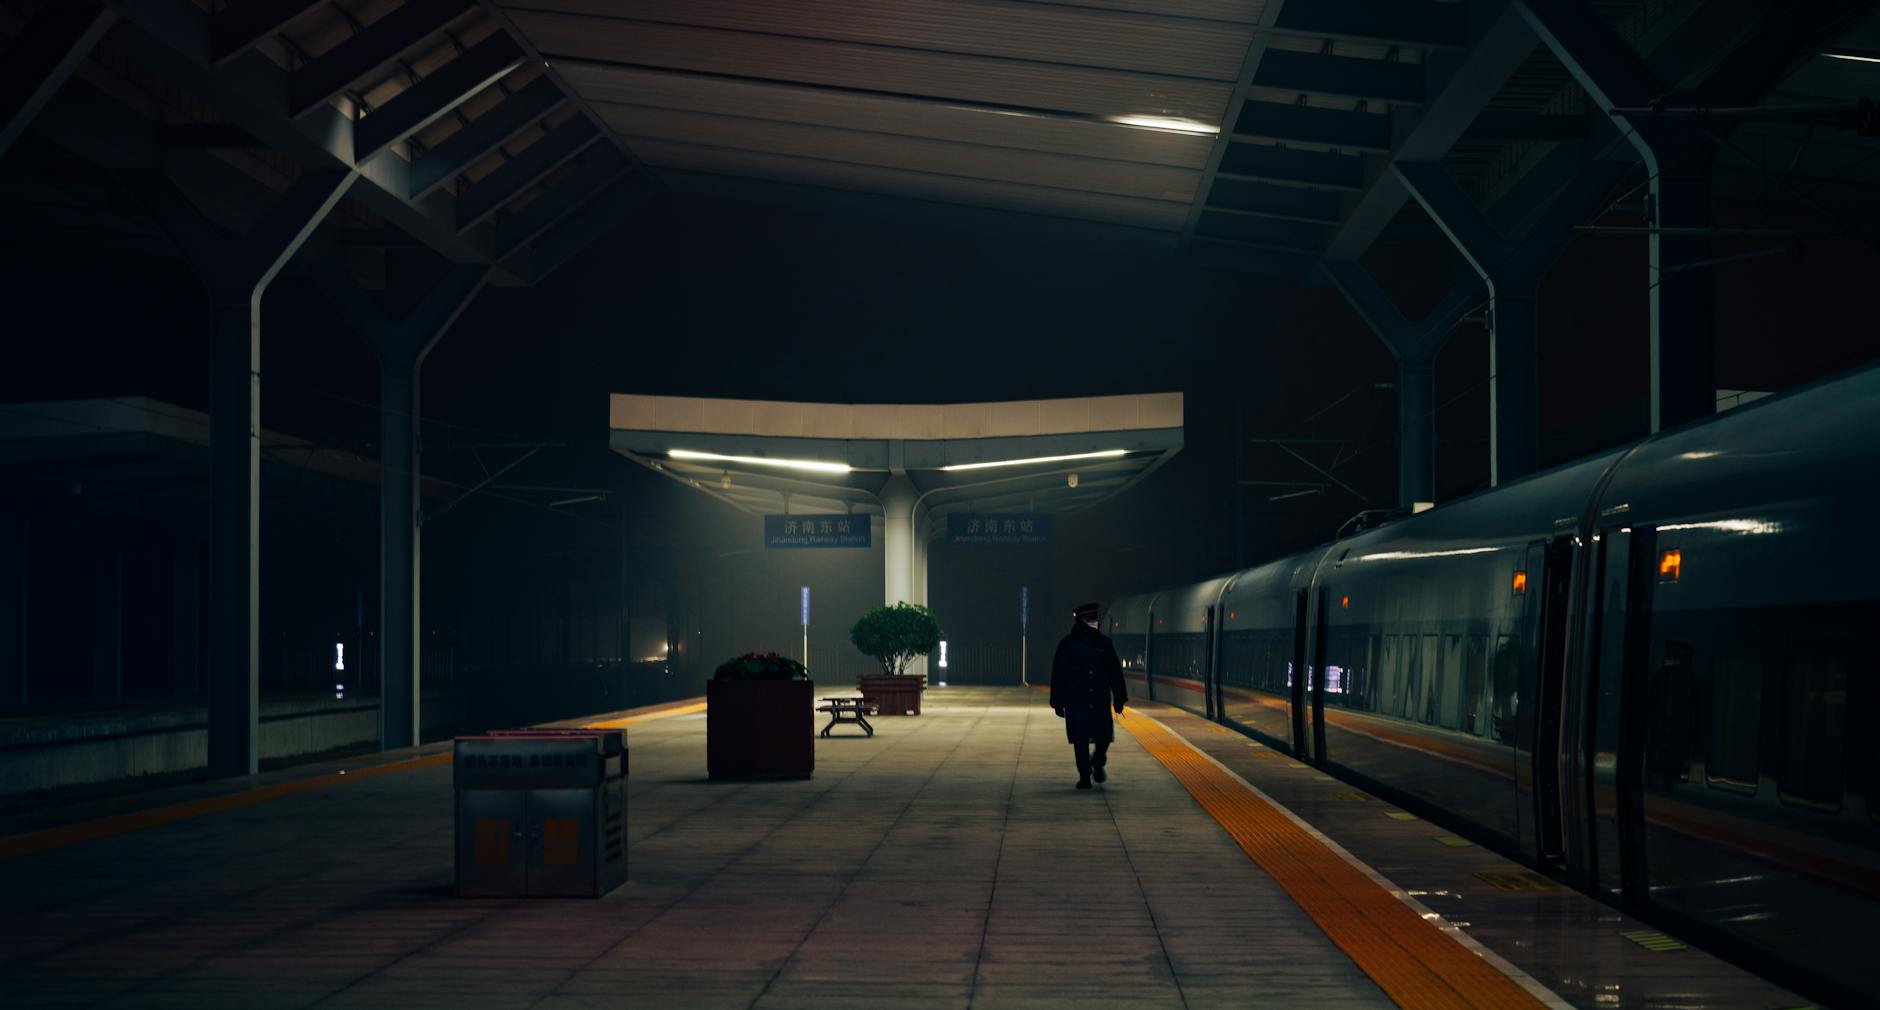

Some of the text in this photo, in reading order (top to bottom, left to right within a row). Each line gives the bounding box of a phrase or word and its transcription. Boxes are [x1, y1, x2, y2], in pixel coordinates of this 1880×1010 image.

[784, 519, 850, 535] 济南东站
[967, 518, 1033, 534] 济南东站
